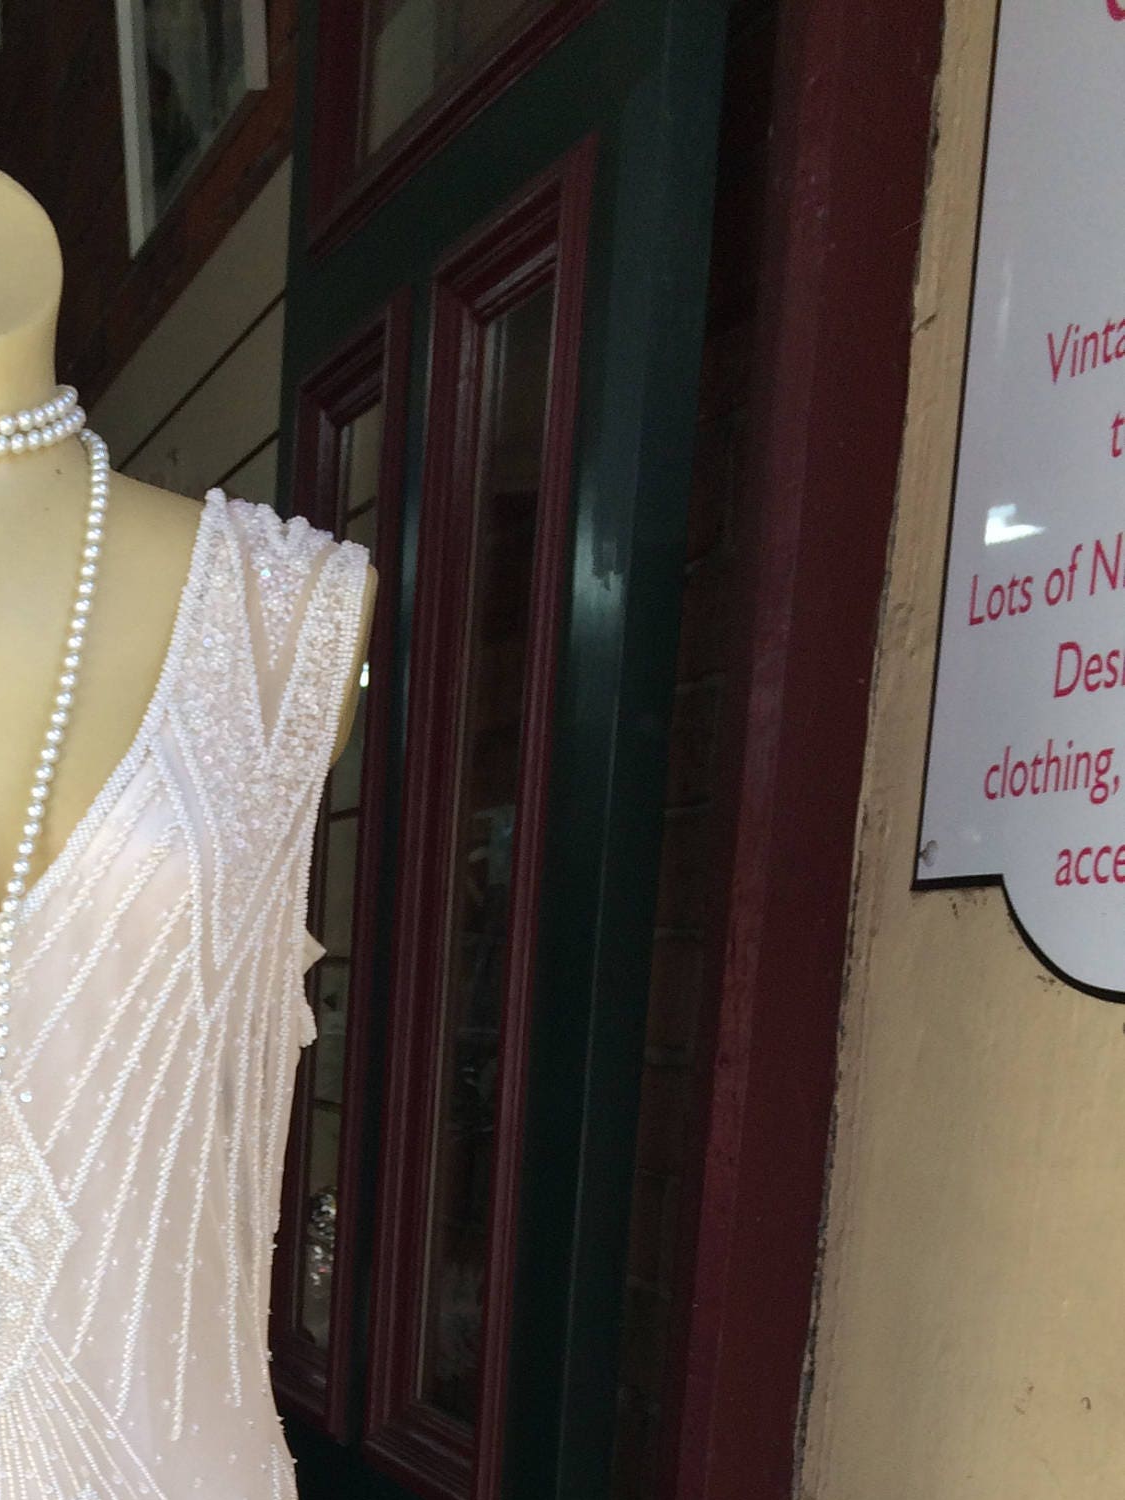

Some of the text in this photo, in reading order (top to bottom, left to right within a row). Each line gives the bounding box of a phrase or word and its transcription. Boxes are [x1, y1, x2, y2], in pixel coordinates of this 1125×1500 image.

[969, 532, 1125, 626] Lots of N
[984, 738, 1120, 805] clothing,
[1055, 845, 1125, 886] acce
